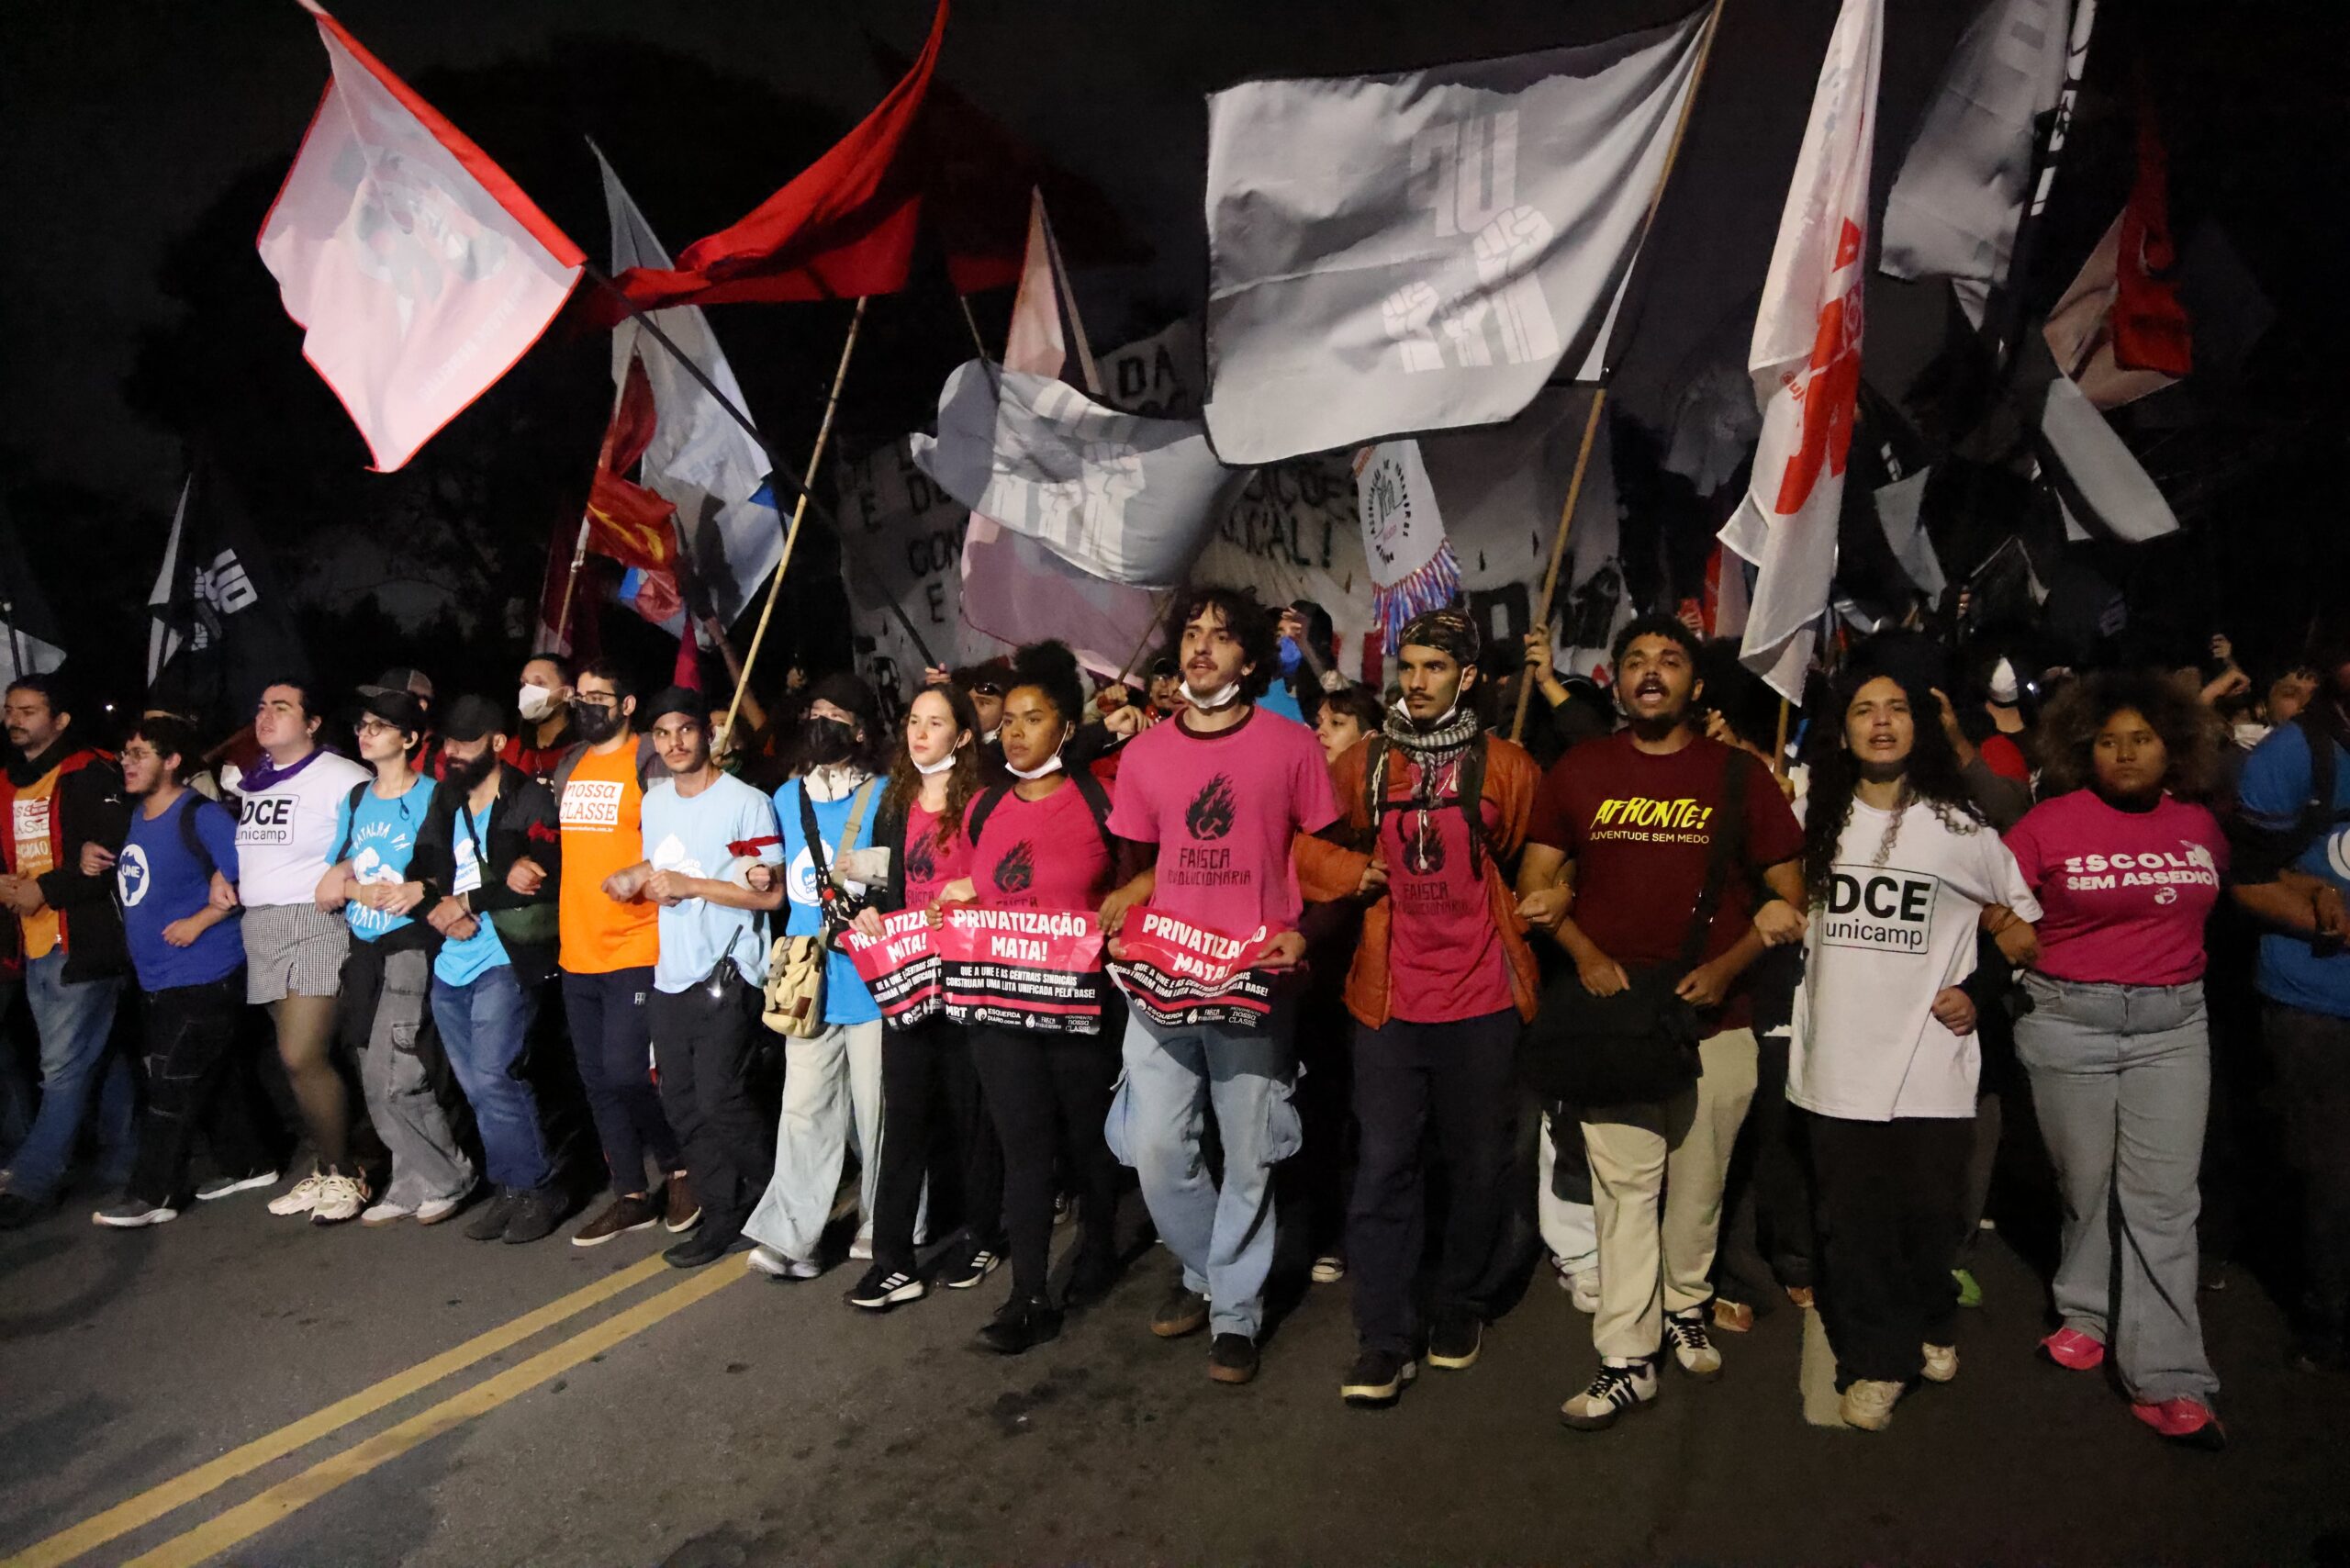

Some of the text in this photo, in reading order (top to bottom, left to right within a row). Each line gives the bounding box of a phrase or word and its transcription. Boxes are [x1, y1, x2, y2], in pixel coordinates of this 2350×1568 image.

[240, 800, 293, 826] DCE
[1590, 797, 1713, 830] AFRONTE!
[1590, 830, 1709, 844] JUVENTUDE SEM MEDO
[1179, 844, 1231, 869] FAÍSCA
[122, 863, 140, 879] UNE
[2066, 868, 2214, 890] SEM ASSÉDIO
[1828, 873, 1931, 923] DCE
[953, 909, 1087, 940] PRIVATIZAÇÃO
[1826, 918, 1922, 950] unicamp
[991, 935, 1047, 962] MATA!
[960, 966, 1077, 986] QUE A UNE E AS CENTRAIS SINDICAIS
[1134, 963, 1150, 973] QUE
[1149, 969, 1155, 977] A
[1156, 973, 1170, 987] UNE
[946, 977, 1095, 999] CONSTRUAM UMA LUTA UNIFICADA PELA BASE!
[1155, 984, 1173, 998] UMA
[1172, 987, 1190, 997] LUTA
[1245, 981, 1269, 997] BASE!
[946, 1004, 968, 1019] MRT
[988, 1008, 1021, 1019] ESQUERDA
[1228, 1016, 1257, 1028] CLASSE
